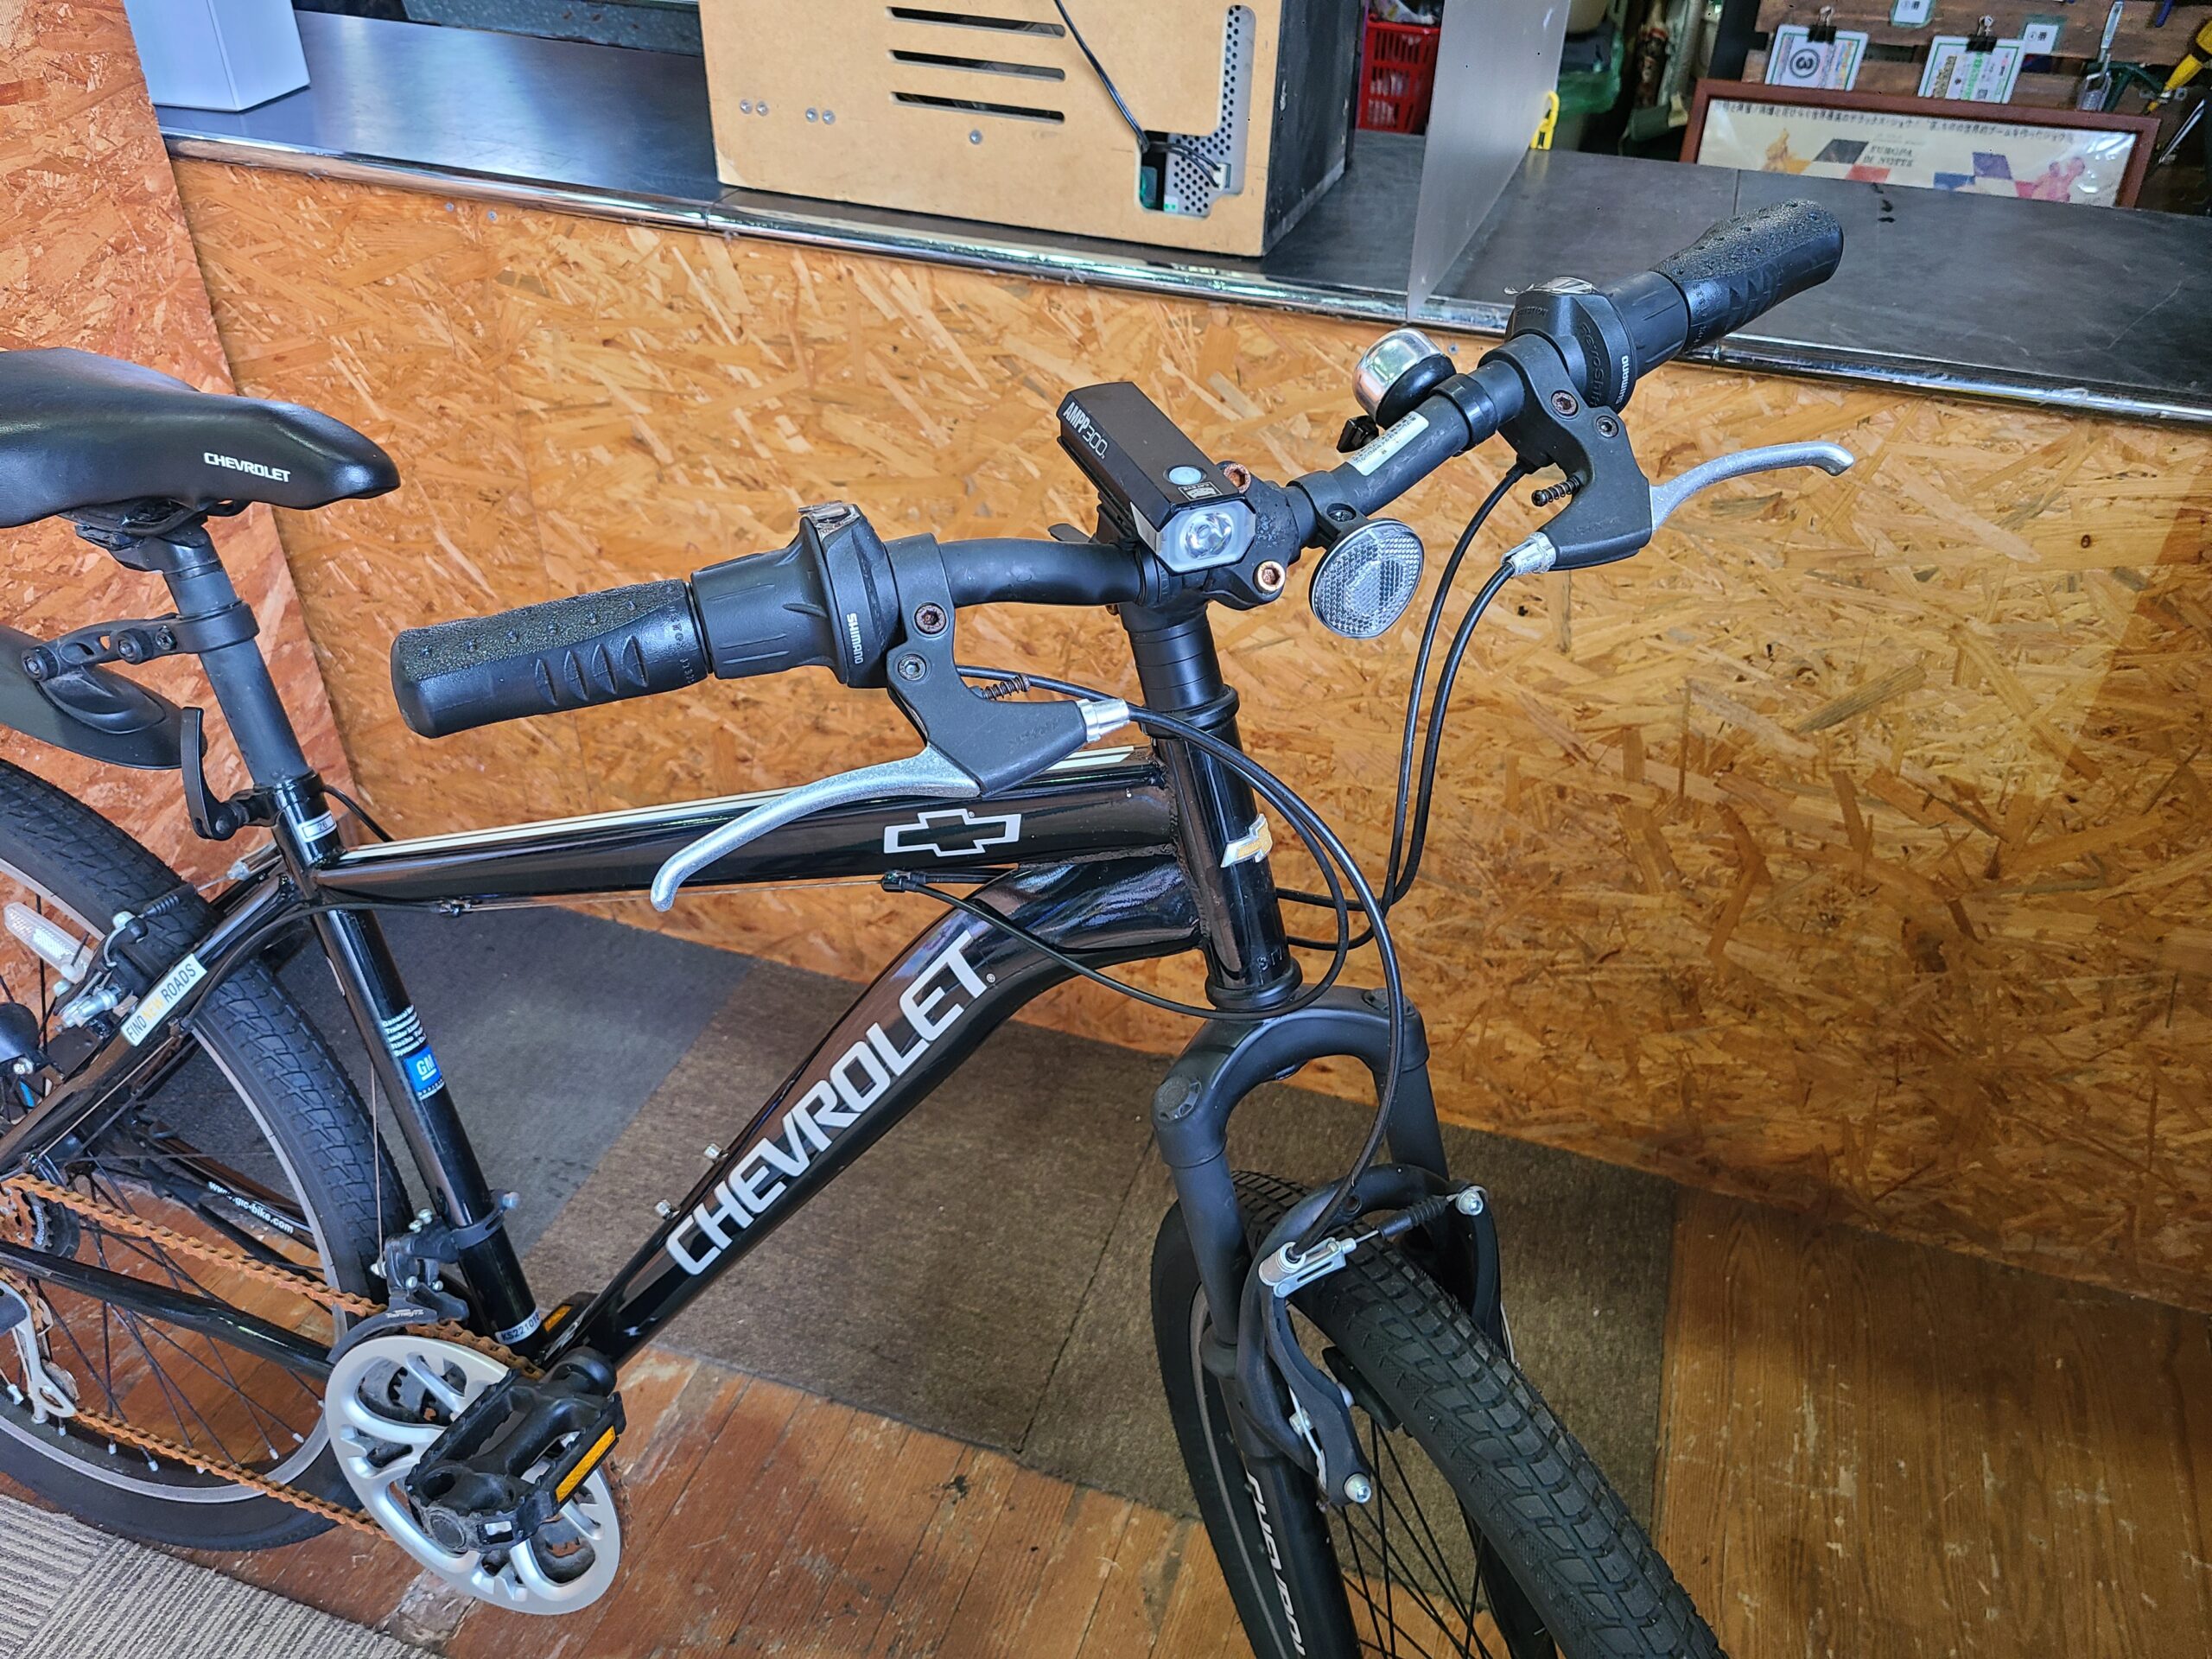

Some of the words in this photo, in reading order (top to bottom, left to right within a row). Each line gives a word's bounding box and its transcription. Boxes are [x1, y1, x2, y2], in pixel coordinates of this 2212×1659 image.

[1615, 354, 1630, 405] SHIMANO
[203, 451, 291, 483] CHEVROLET
[846, 612, 864, 665] SHIMANO
[317, 821, 328, 831] 26
[125, 1014, 147, 1041] FIND
[141, 995, 165, 1021] NEW
[161, 963, 197, 1003] ROADS
[416, 1053, 436, 1077] GM
[665, 929, 988, 1276] CHEVROLET
